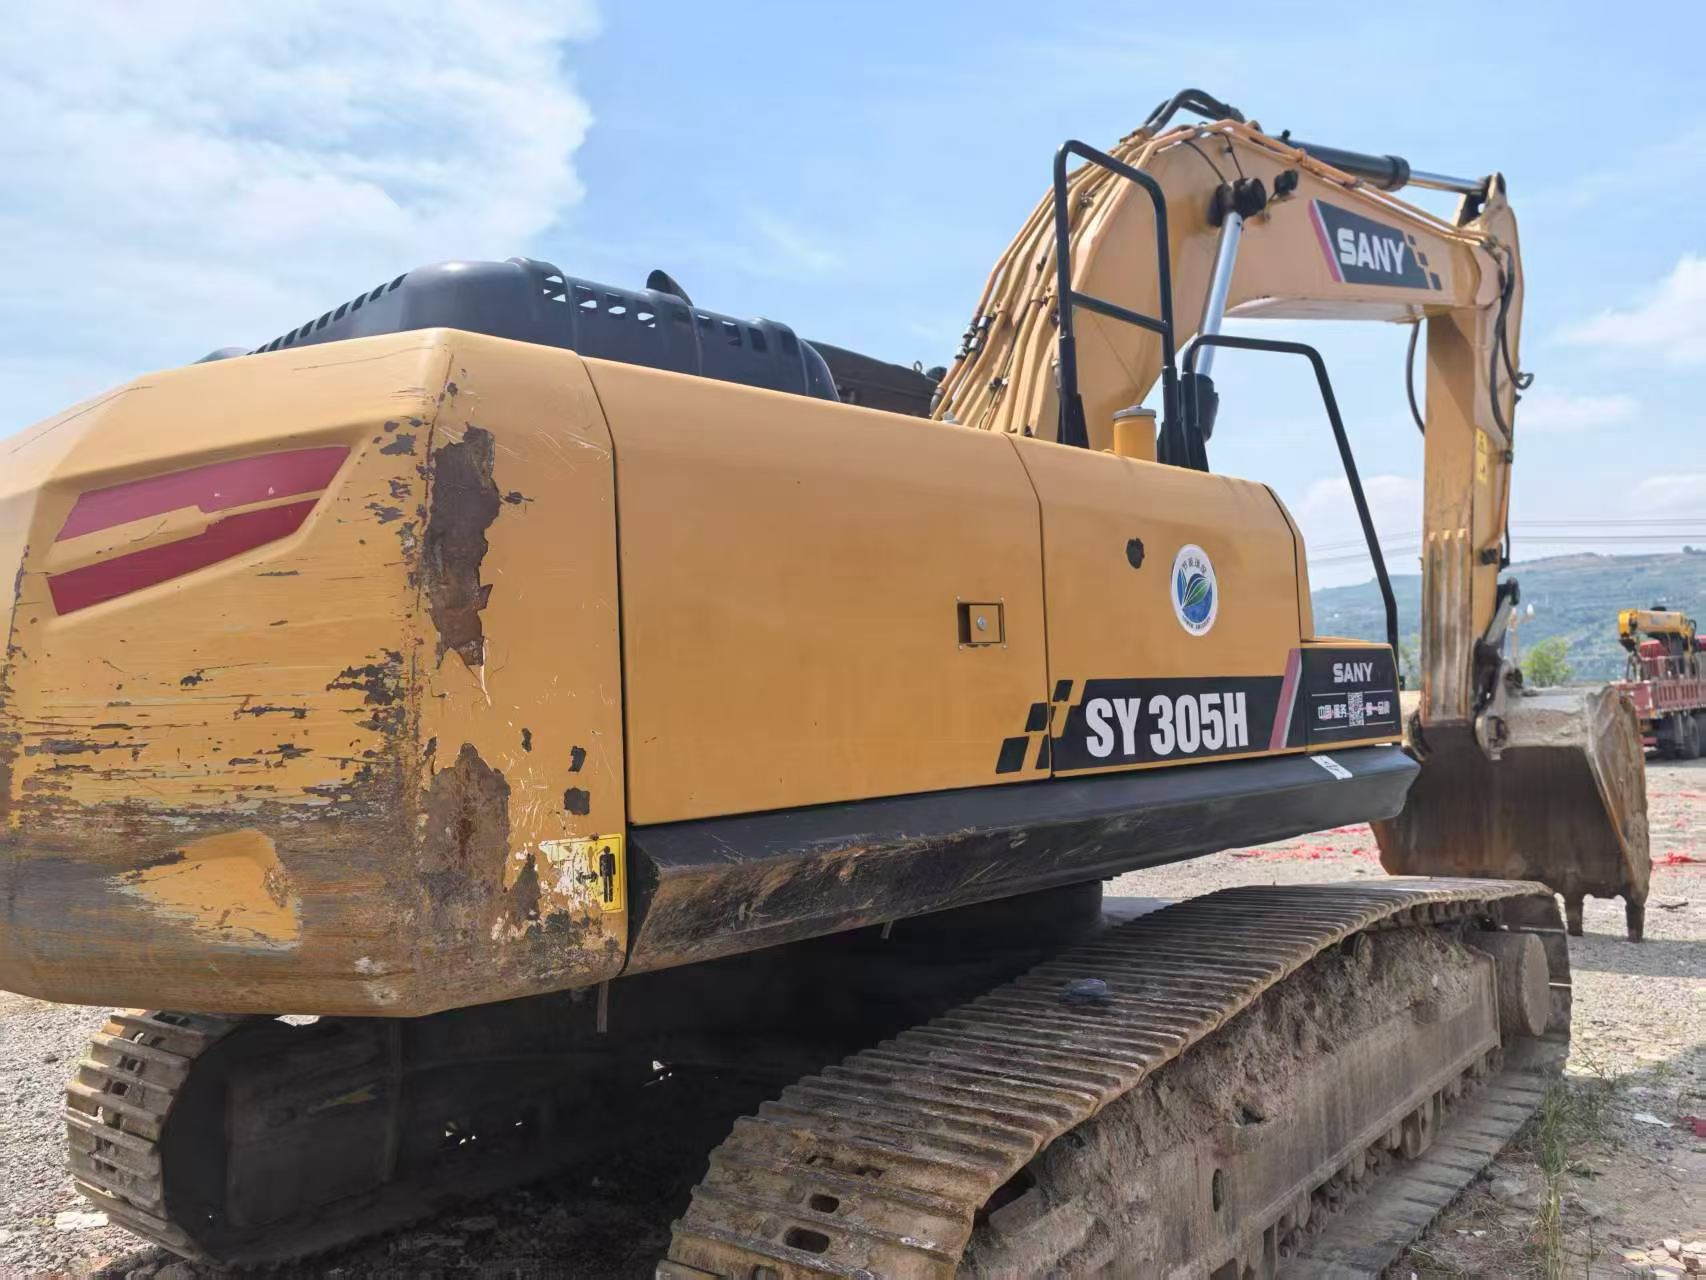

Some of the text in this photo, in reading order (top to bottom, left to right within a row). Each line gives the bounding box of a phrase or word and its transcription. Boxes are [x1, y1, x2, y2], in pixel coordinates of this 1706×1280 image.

[1337, 227, 1405, 275] SANY
[1333, 662, 1373, 684] SANY
[1085, 691, 1249, 758] SY 305H
